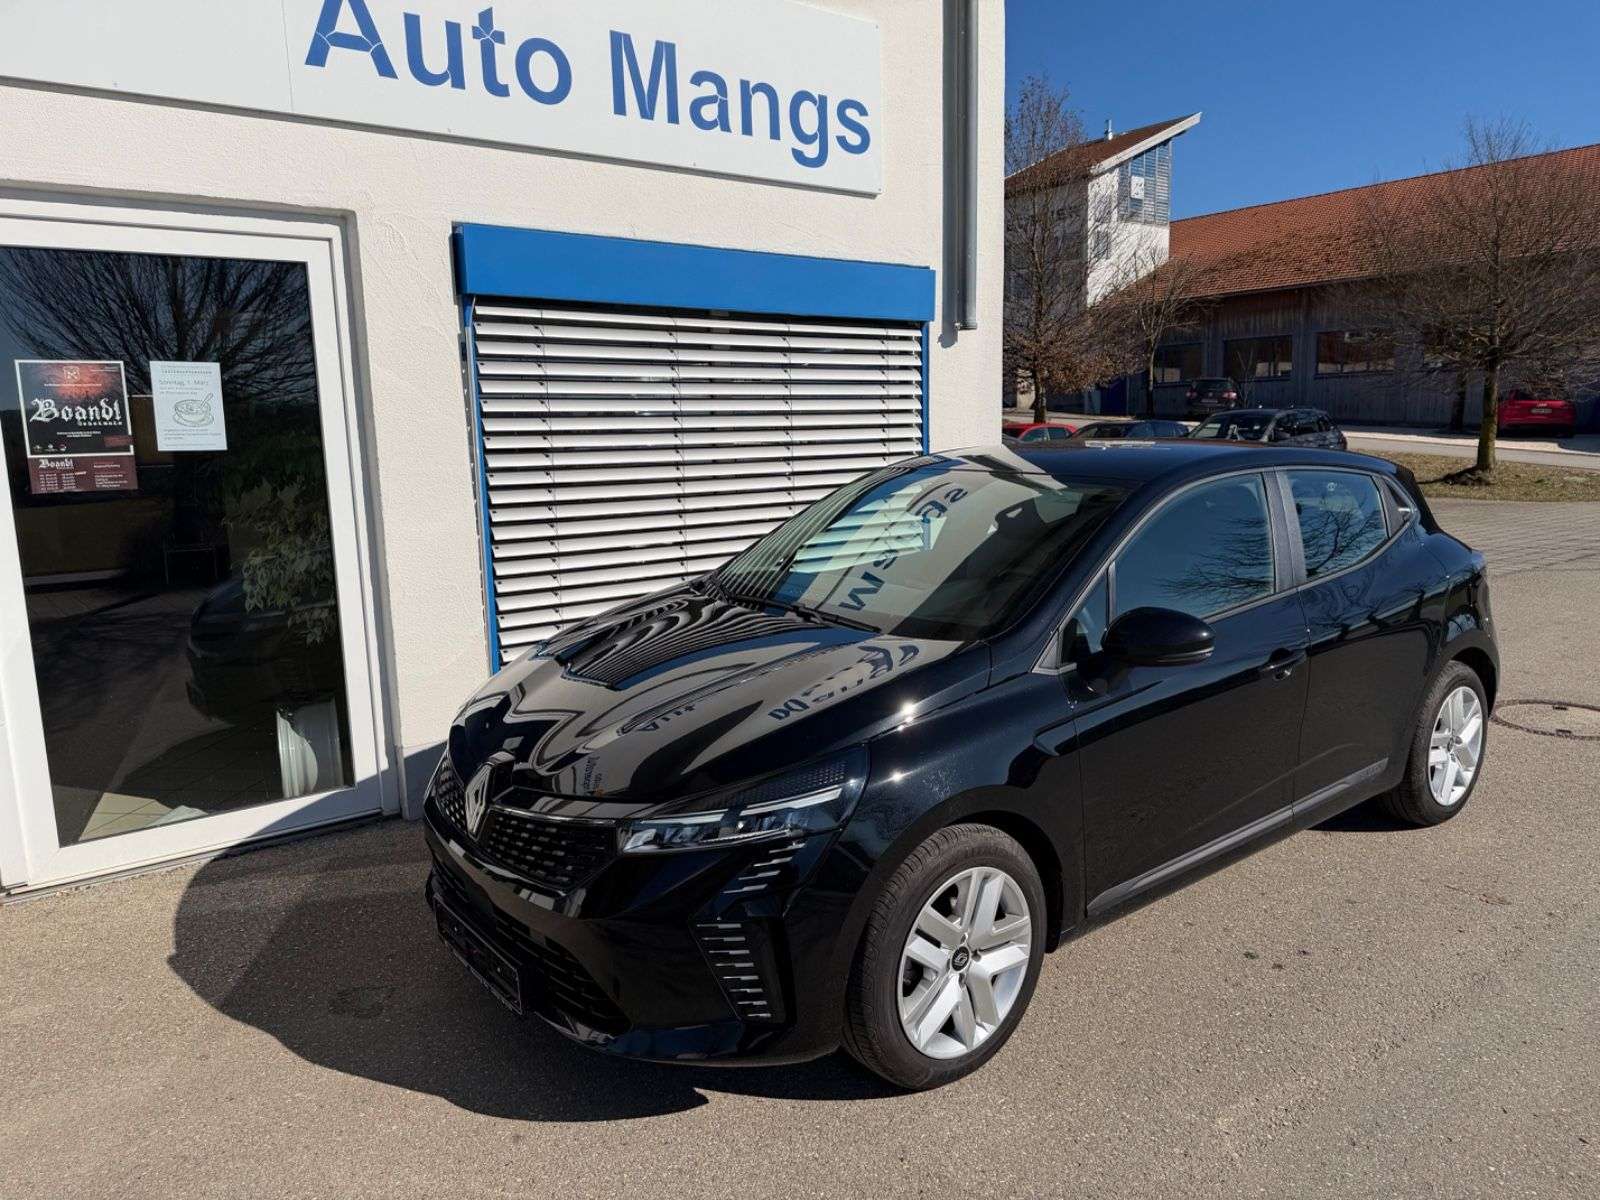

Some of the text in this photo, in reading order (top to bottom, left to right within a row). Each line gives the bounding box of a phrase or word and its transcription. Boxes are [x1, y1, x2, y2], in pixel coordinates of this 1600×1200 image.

[304, 0, 871, 169] Auto Mangs
[29, 398, 123, 423] Boandl
